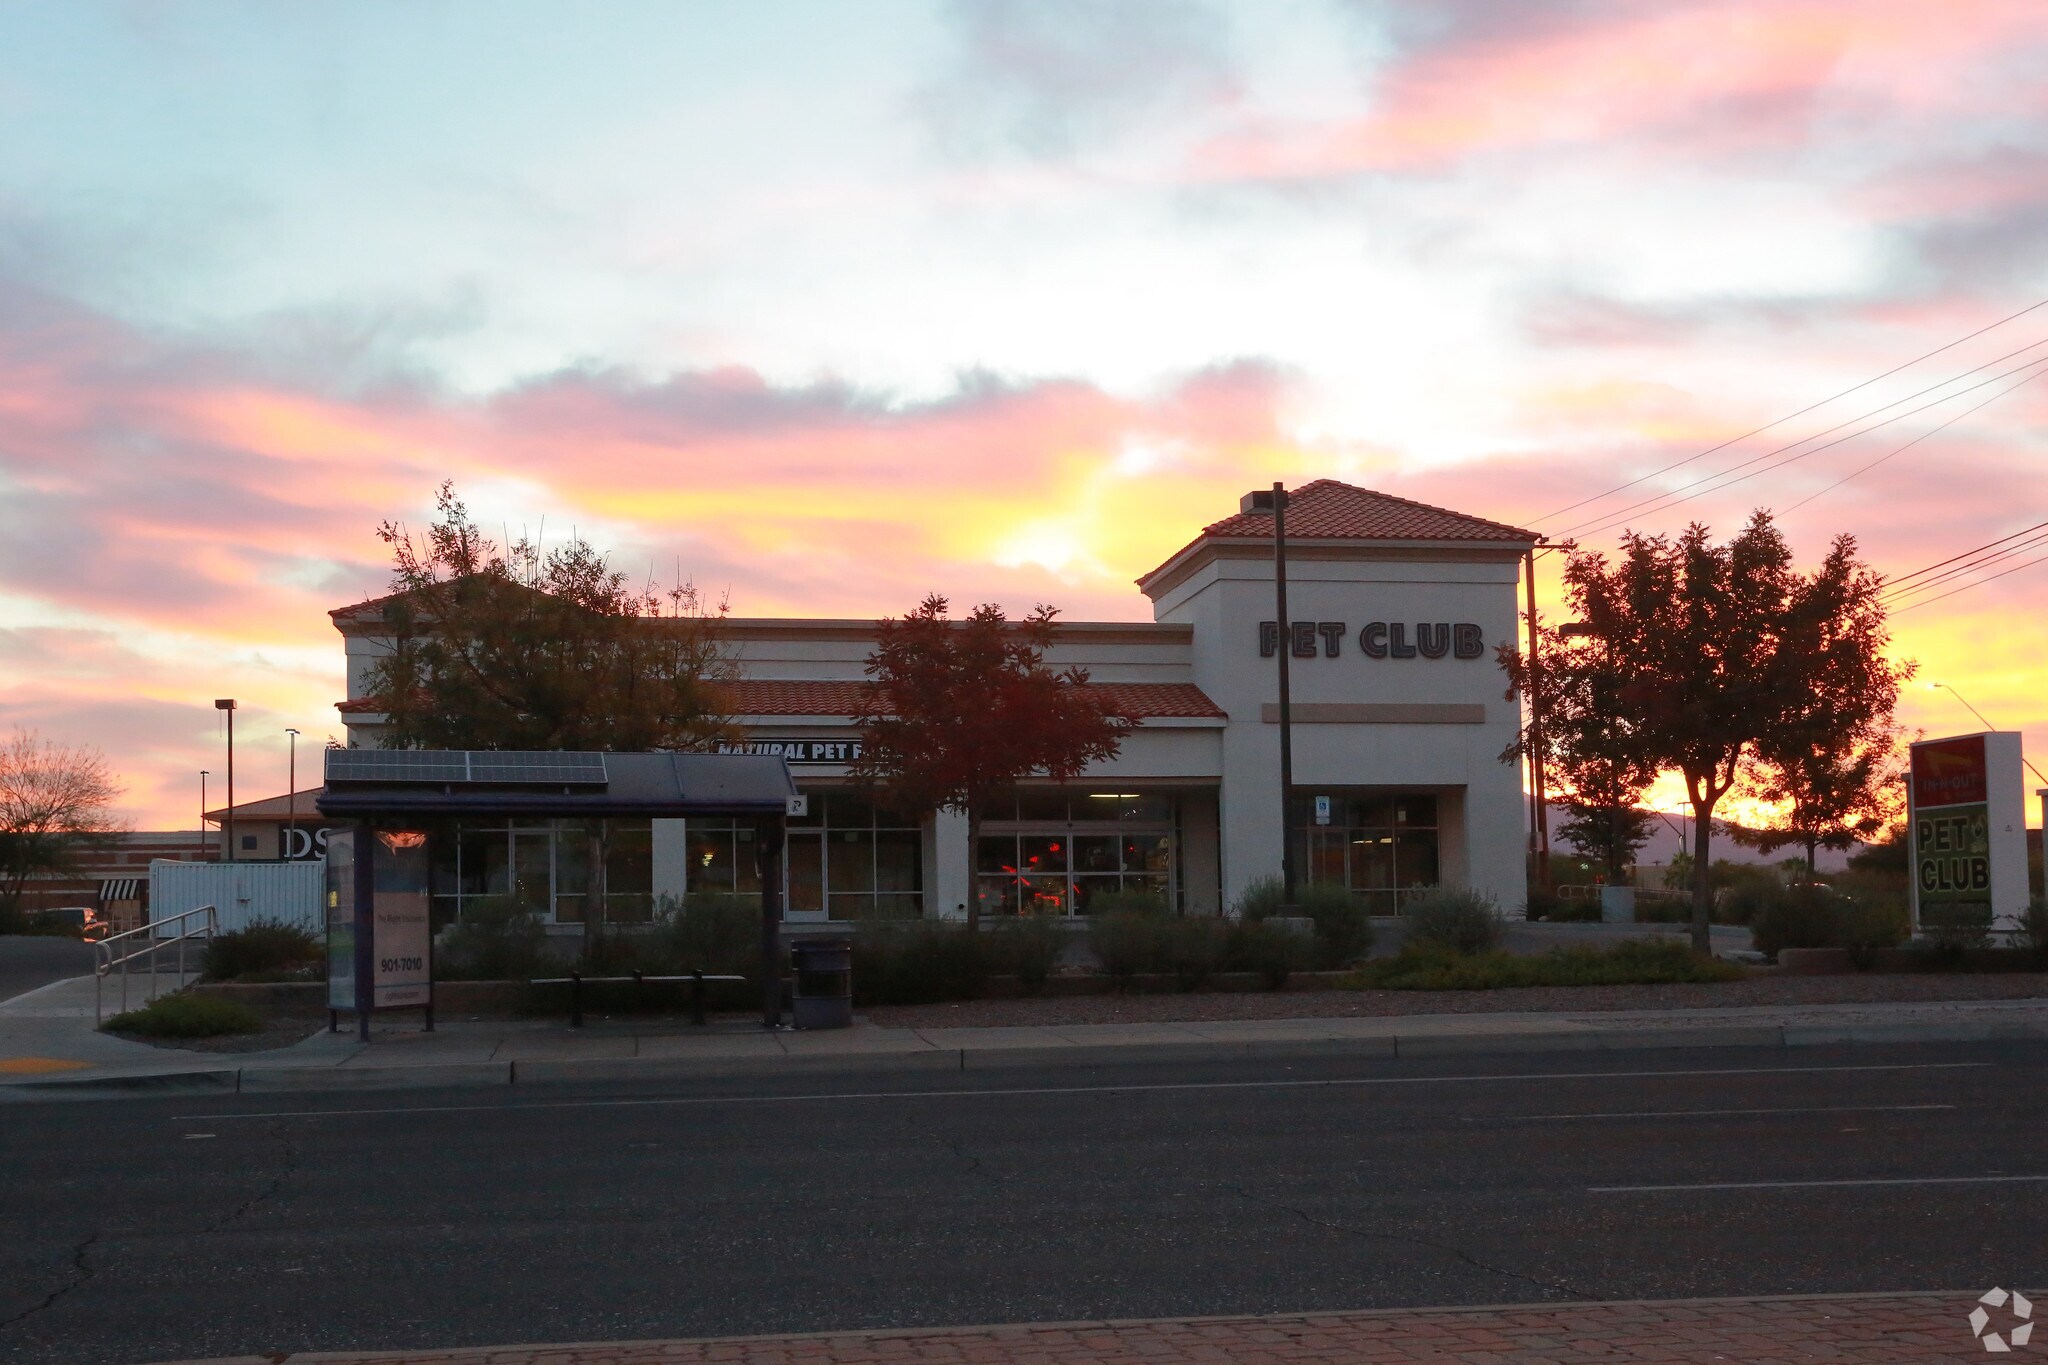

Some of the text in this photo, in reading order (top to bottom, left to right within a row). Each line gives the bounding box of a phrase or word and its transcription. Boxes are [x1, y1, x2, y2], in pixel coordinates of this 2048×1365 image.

[1259, 621, 1485, 659] PET CLUB
[812, 744, 848, 759] PET
[1918, 816, 1969, 853] PET
[1920, 856, 1989, 893] CLUB
[381, 957, 423, 973] 901-7010
